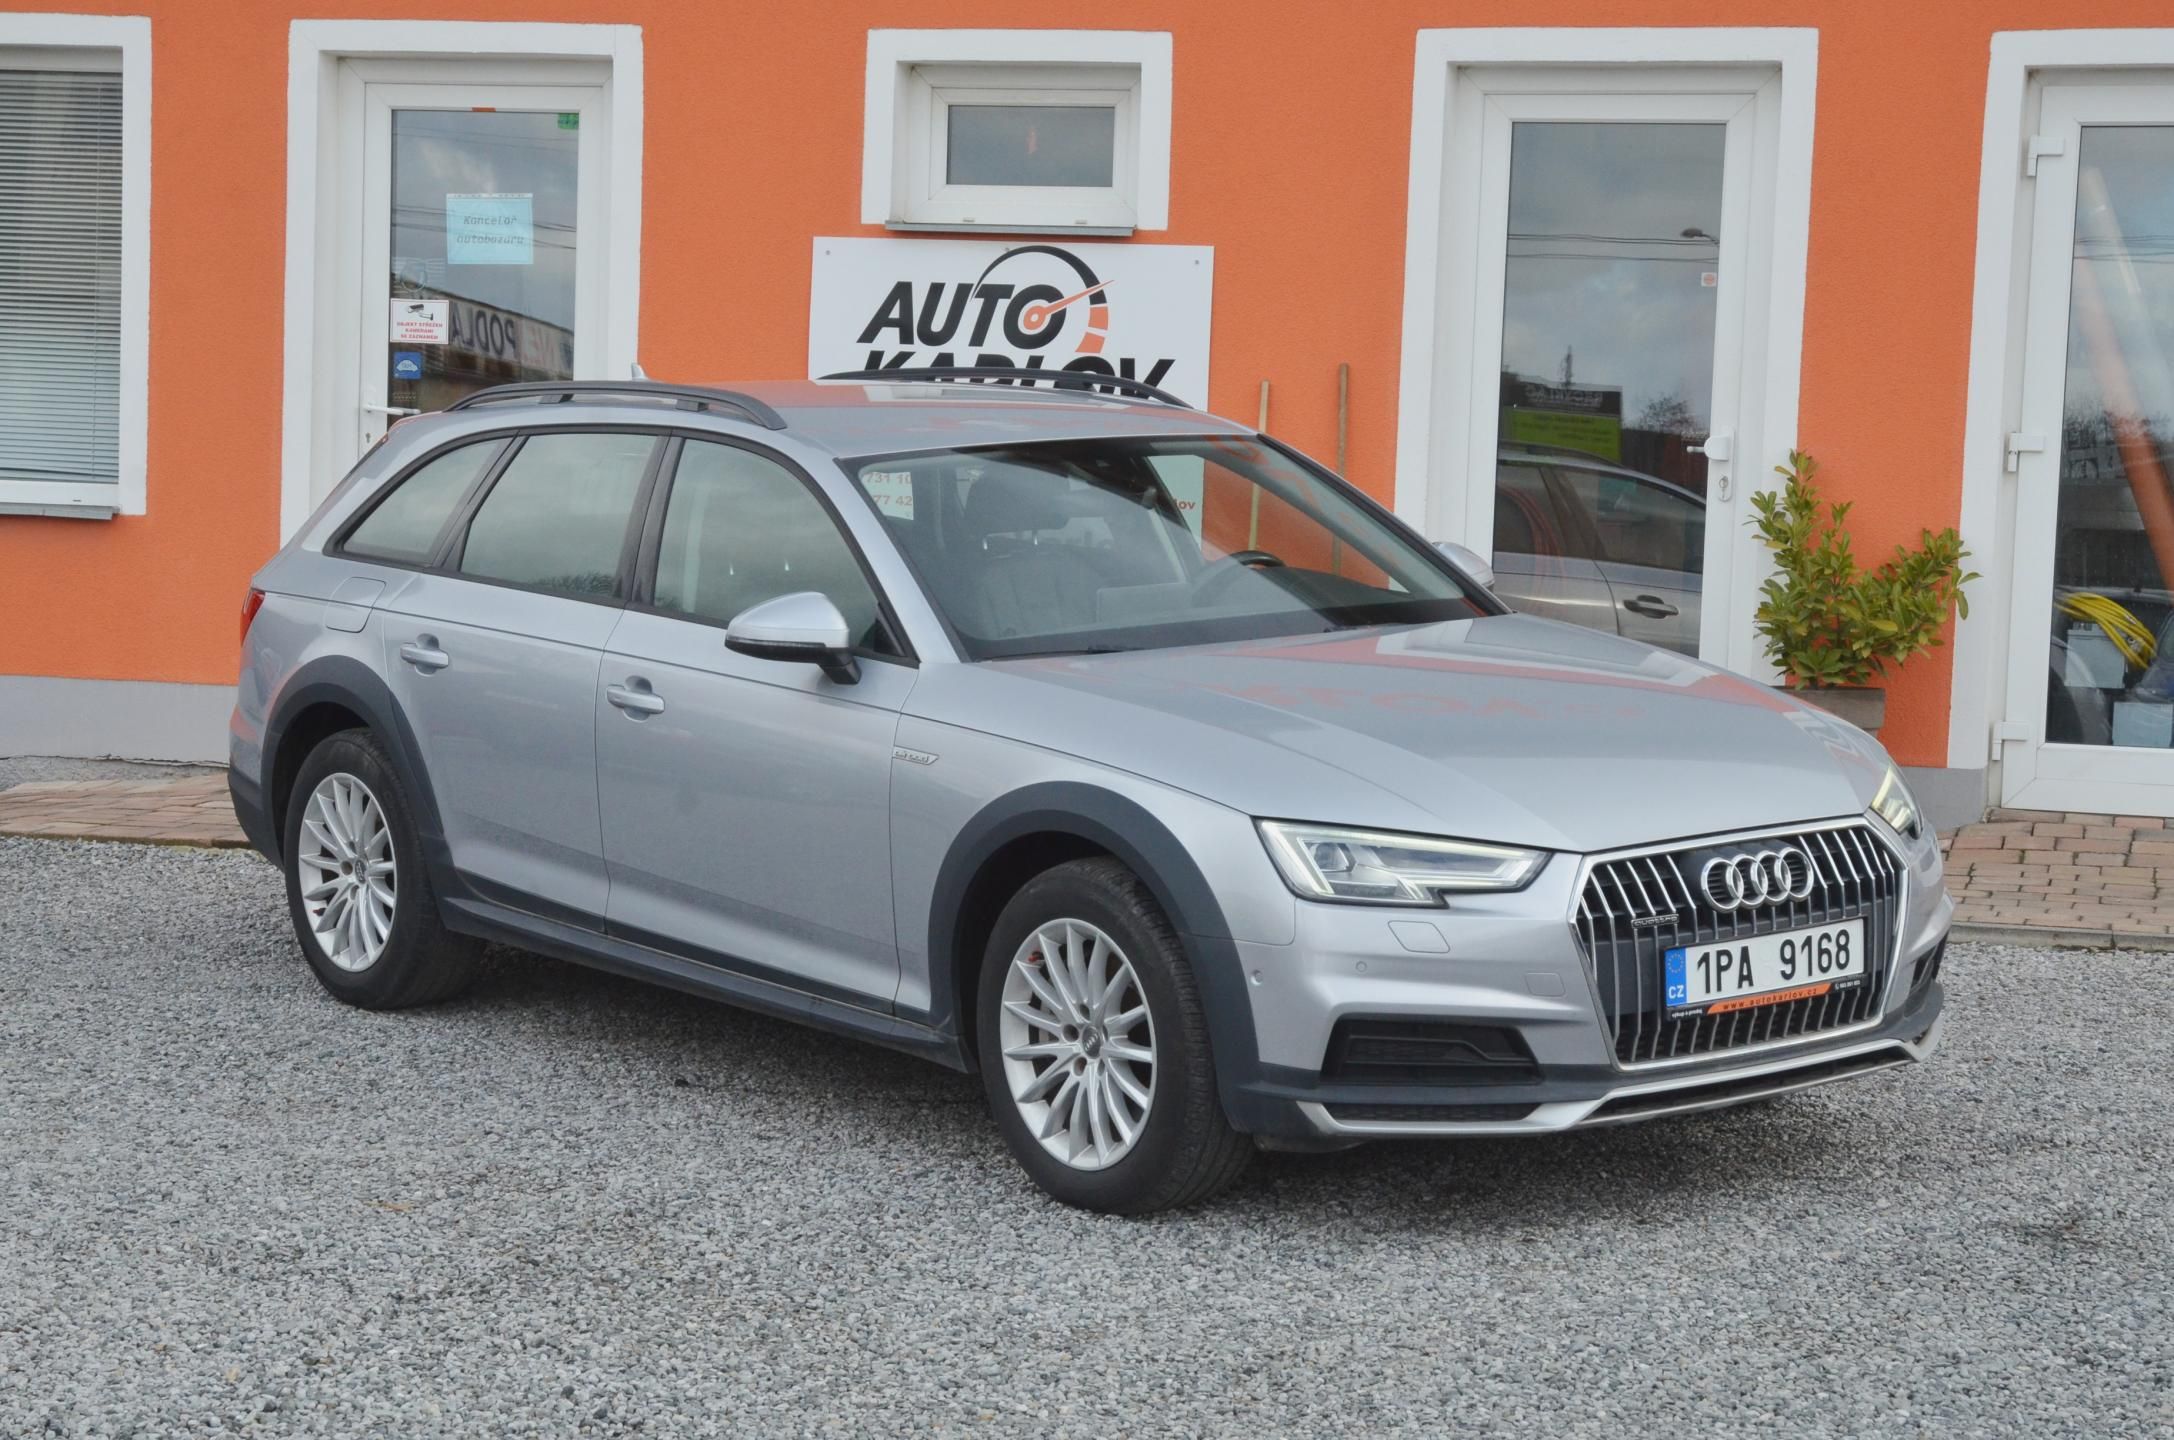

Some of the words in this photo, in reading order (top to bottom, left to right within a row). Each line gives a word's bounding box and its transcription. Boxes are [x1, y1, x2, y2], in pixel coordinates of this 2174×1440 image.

[856, 280, 1068, 350] AUTO
[1668, 985, 1684, 999] CZ
[1697, 946, 1753, 993] 1PA
[1780, 929, 1850, 980] 9168
